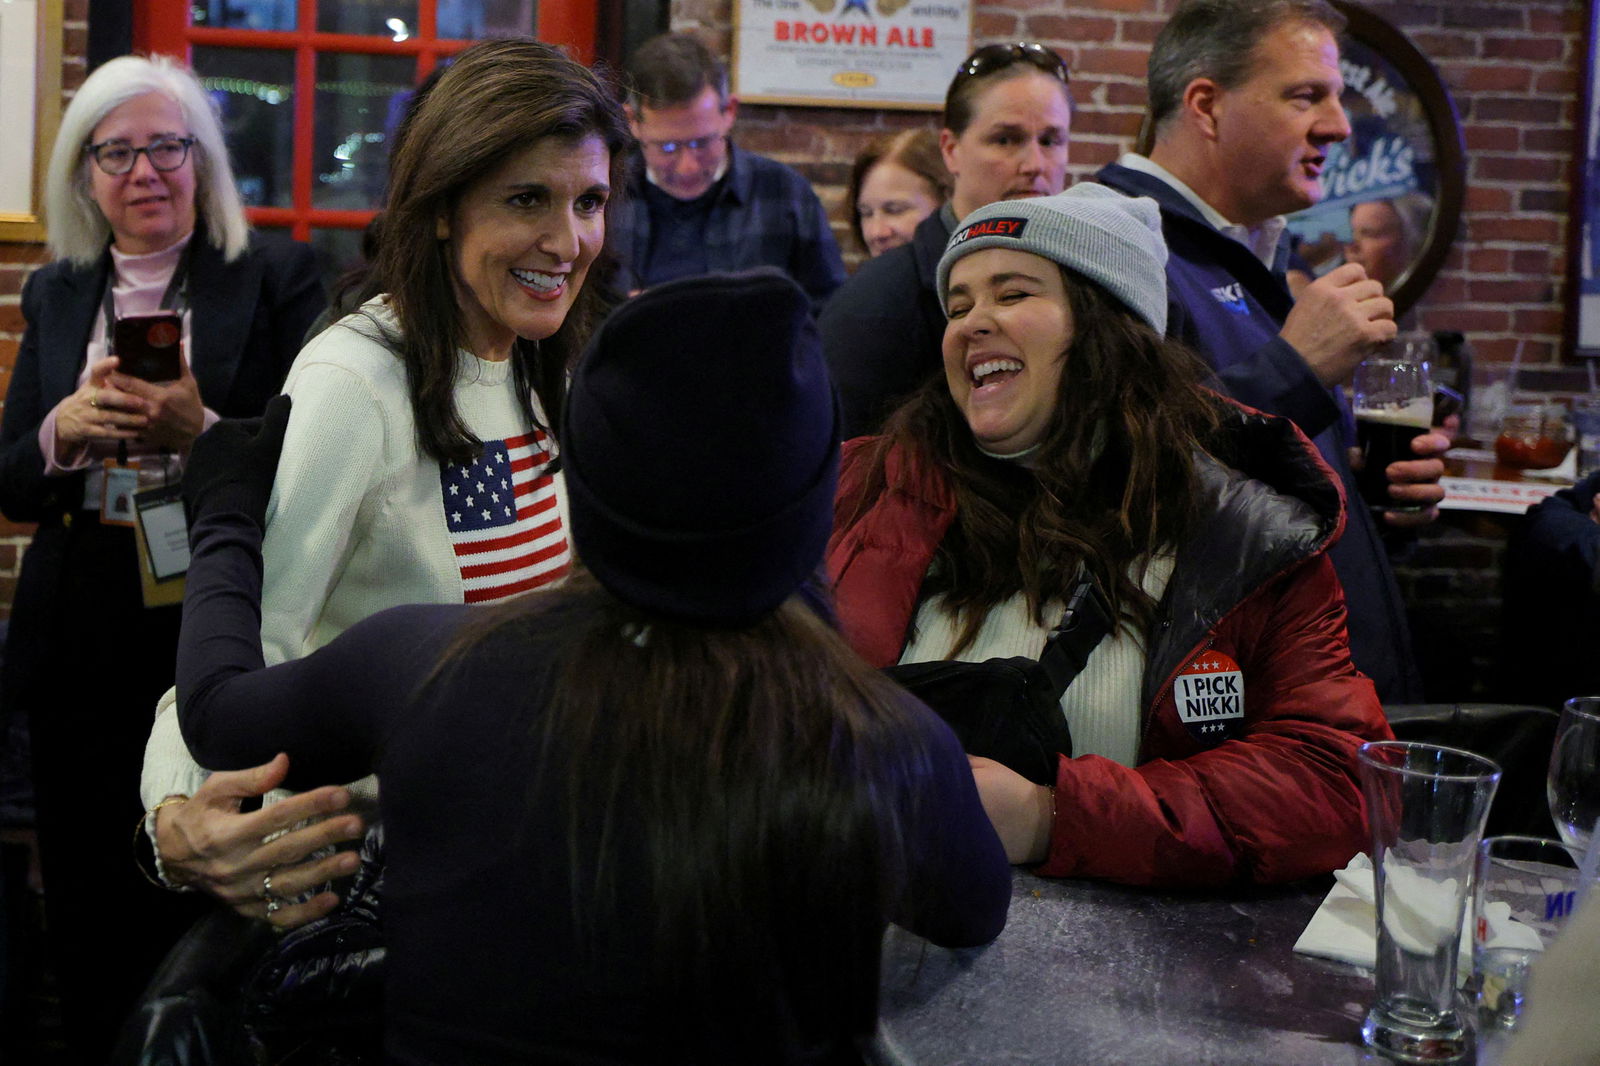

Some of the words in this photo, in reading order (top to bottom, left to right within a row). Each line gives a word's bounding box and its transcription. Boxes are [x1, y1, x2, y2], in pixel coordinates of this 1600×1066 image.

[774, 20, 877, 46] BROWN
[886, 27, 934, 48] ALE
[967, 221, 1019, 239] HALEY
[1183, 679, 1190, 697] I
[1186, 696, 1240, 717] NIKKI
